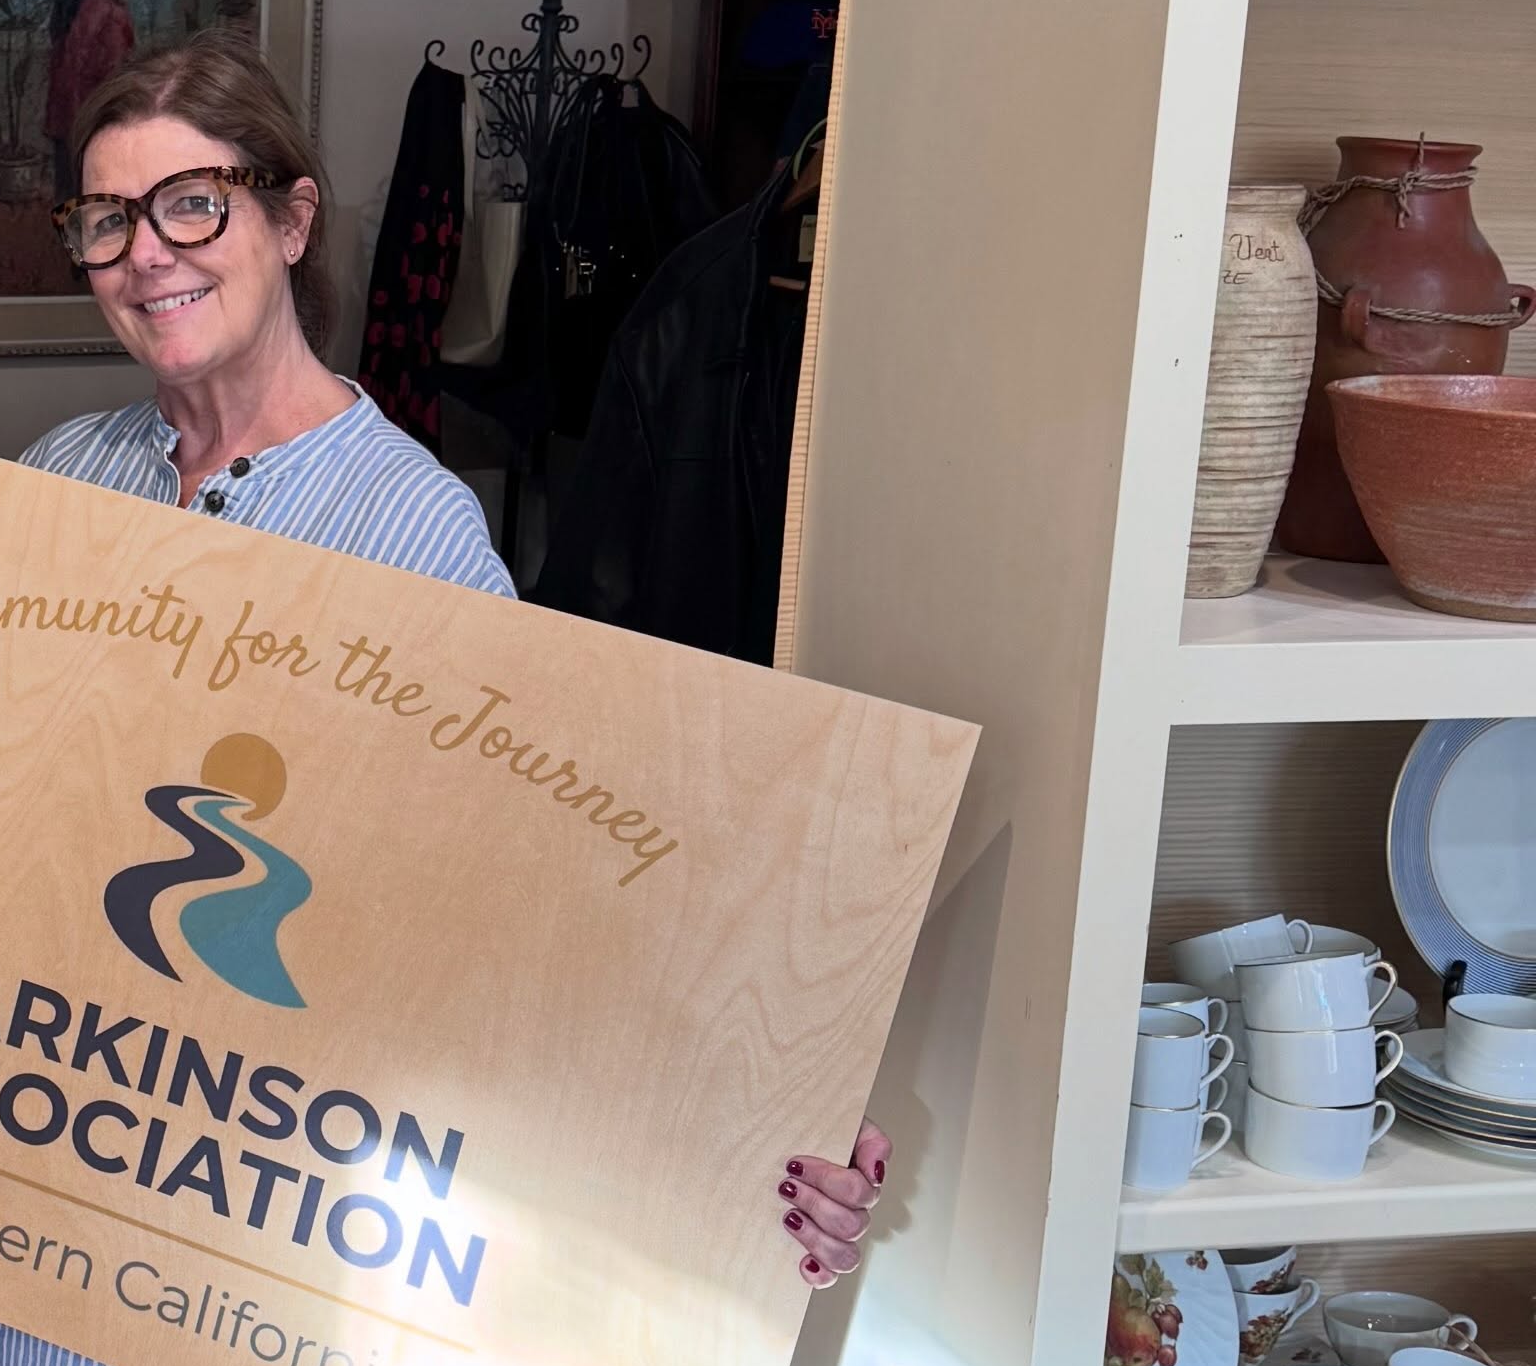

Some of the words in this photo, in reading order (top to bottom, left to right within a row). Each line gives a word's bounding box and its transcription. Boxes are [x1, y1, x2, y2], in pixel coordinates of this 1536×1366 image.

[207, 600, 321, 692] for
[333, 635, 433, 717] the
[428, 684, 679, 888] Journey
